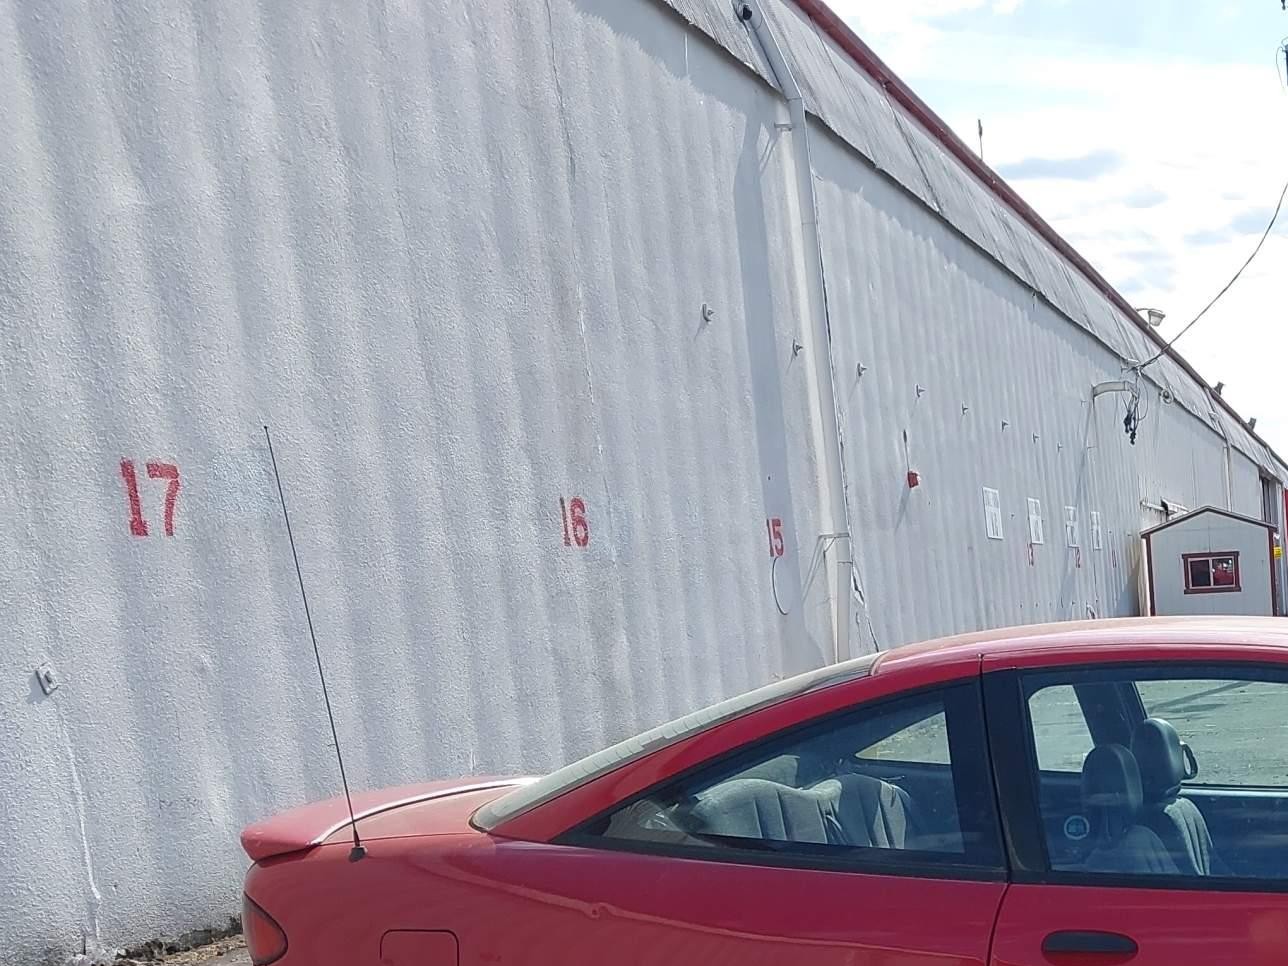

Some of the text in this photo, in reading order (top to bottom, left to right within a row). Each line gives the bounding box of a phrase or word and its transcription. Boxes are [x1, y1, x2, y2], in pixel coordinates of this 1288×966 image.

[120, 457, 182, 538] 17
[560, 497, 590, 548] 16
[765, 518, 784, 557] 15
